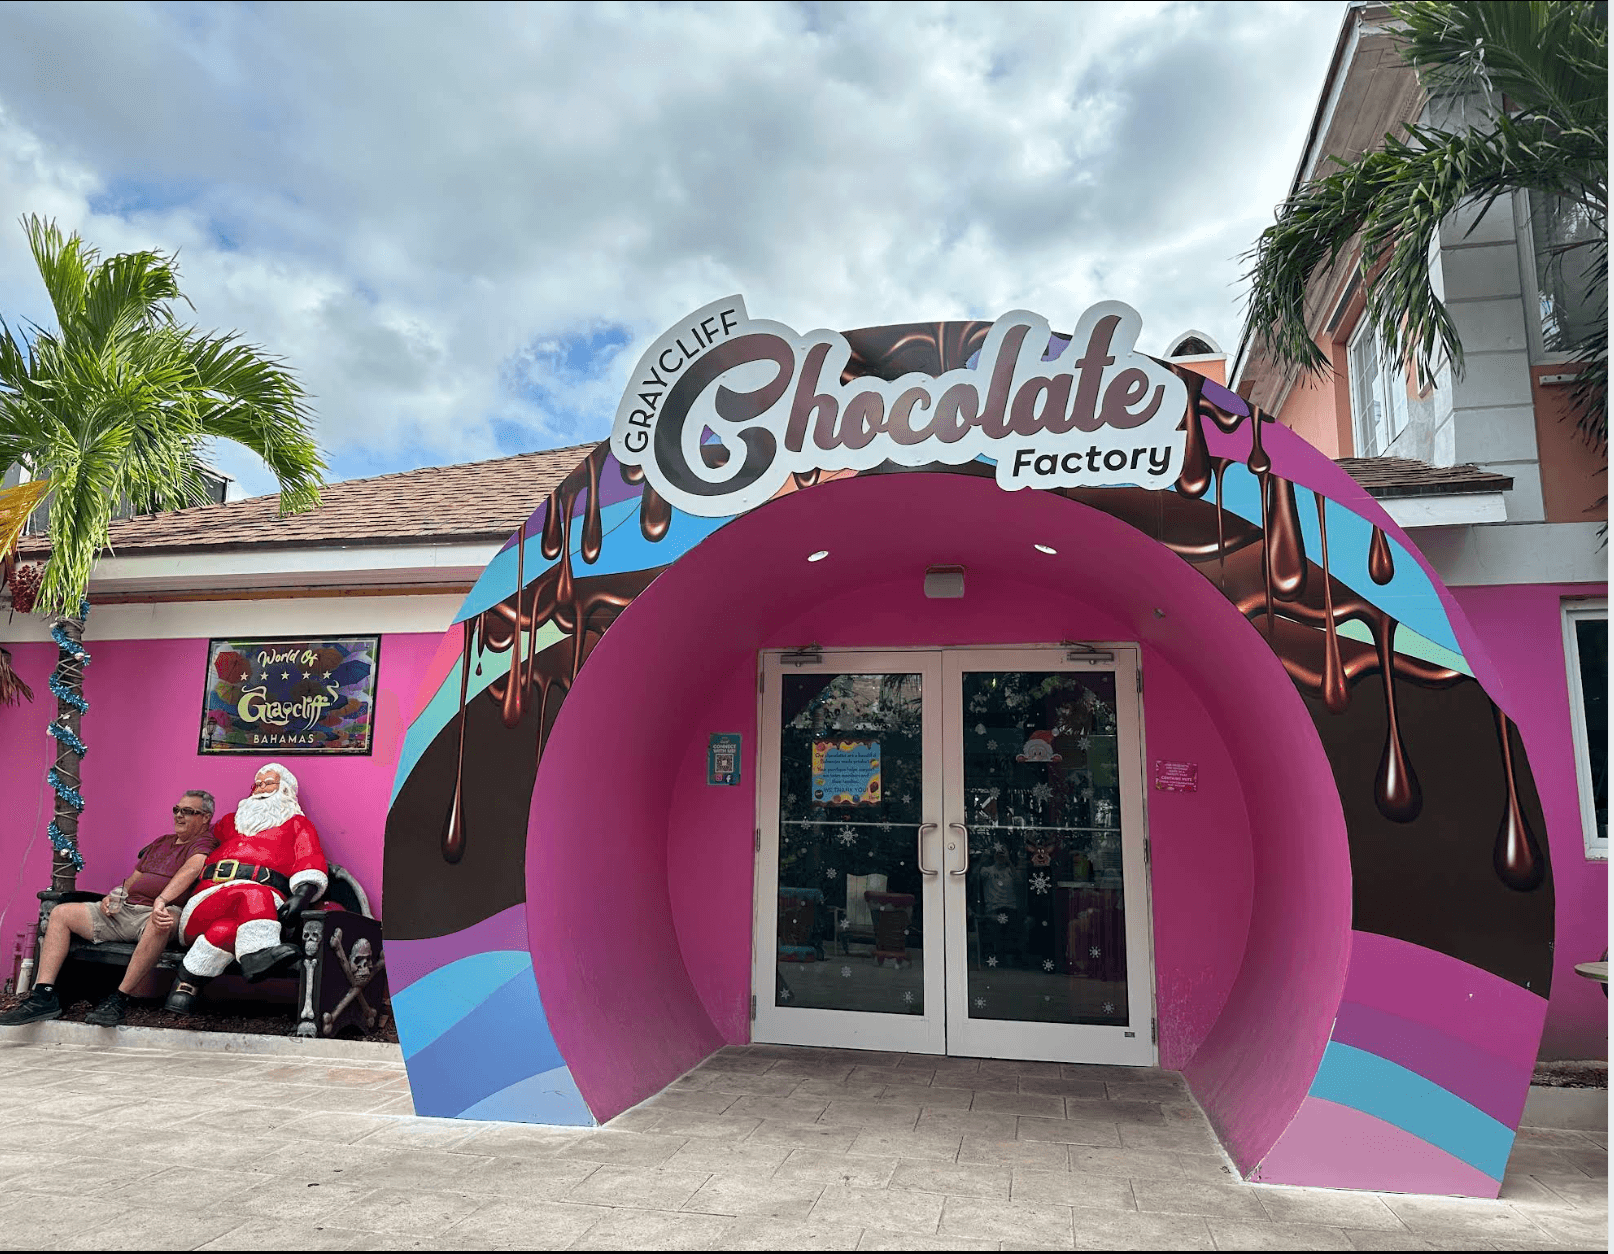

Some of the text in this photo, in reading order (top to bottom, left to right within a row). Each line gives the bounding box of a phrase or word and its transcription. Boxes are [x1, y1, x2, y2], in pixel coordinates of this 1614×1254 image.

[624, 308, 738, 453] GRAYCLIFF
[653, 313, 1166, 497] Chocolate
[1012, 446, 1171, 478] Factory
[257, 648, 319, 667] World Of
[238, 682, 336, 732] Graycliff
[253, 734, 315, 744] BAHAMAS
